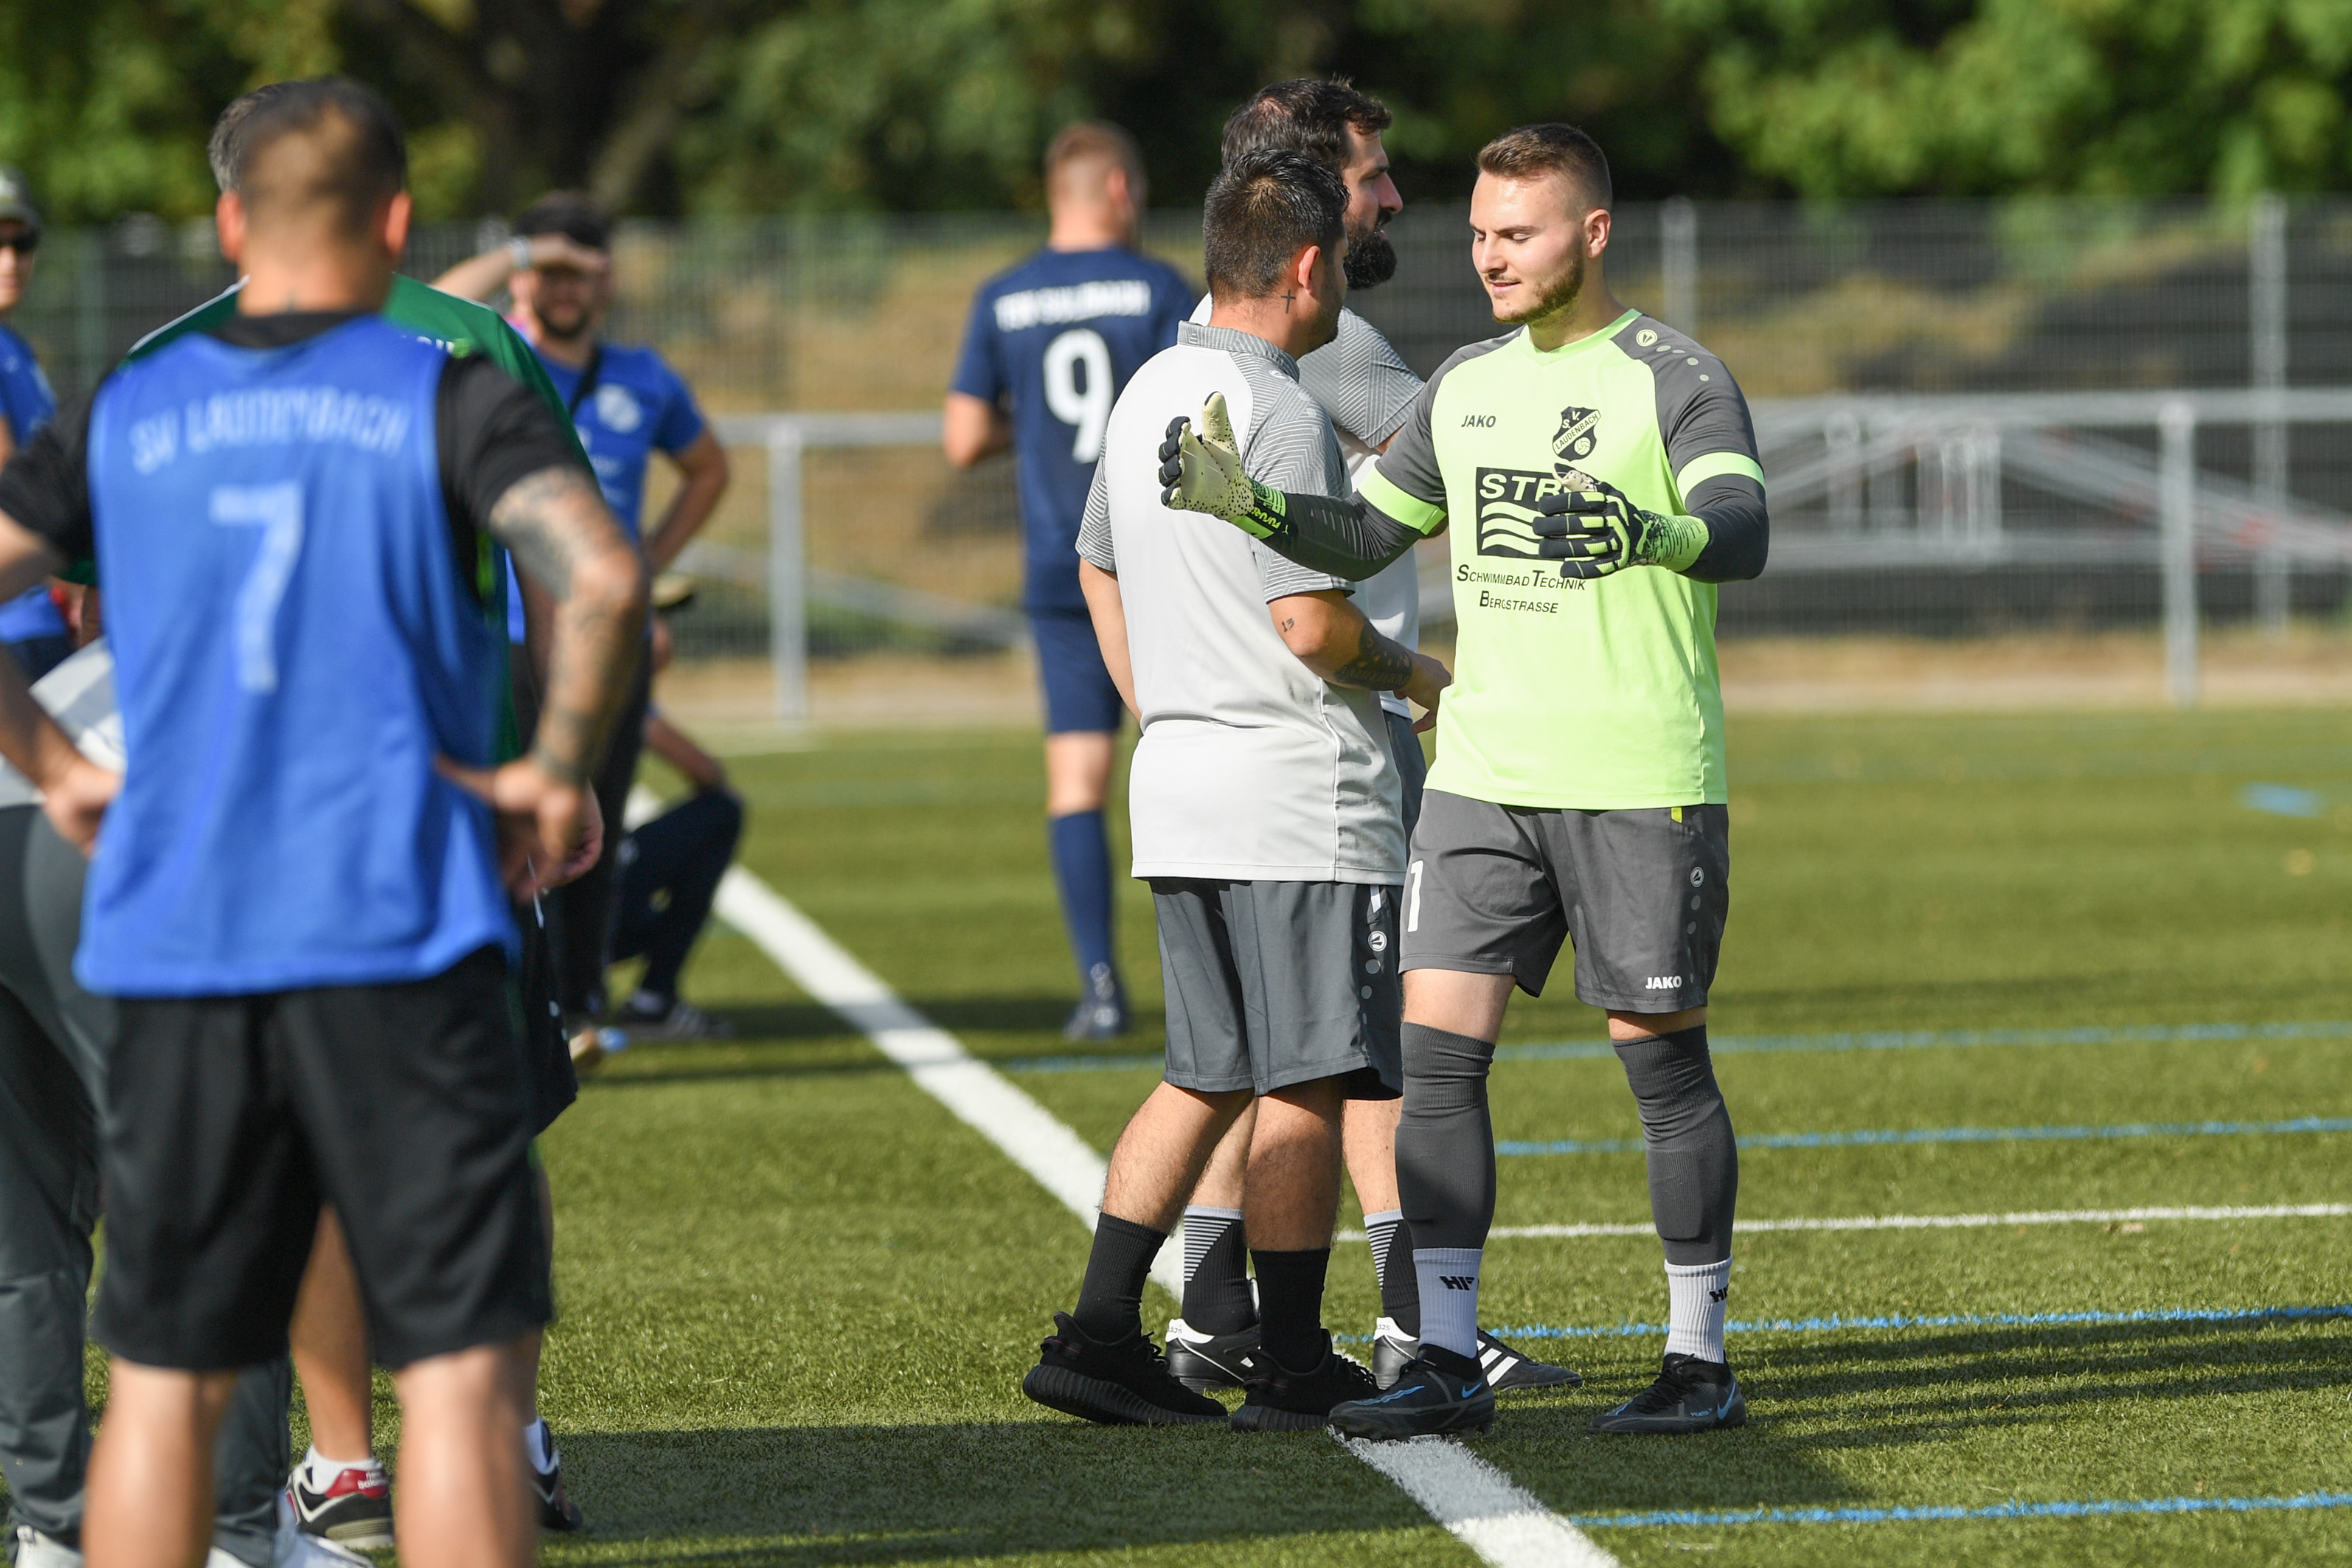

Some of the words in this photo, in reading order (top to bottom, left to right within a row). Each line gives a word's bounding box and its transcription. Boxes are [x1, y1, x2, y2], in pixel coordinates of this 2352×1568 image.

[1041, 328, 1113, 464] 9
[1461, 414, 1496, 428] JAKO
[1555, 413, 1599, 450] LAUDENBACH
[1479, 473, 1572, 502] STR
[207, 479, 304, 695] 7
[1407, 859, 1423, 932] 1
[1645, 975, 1682, 989] JAKO
